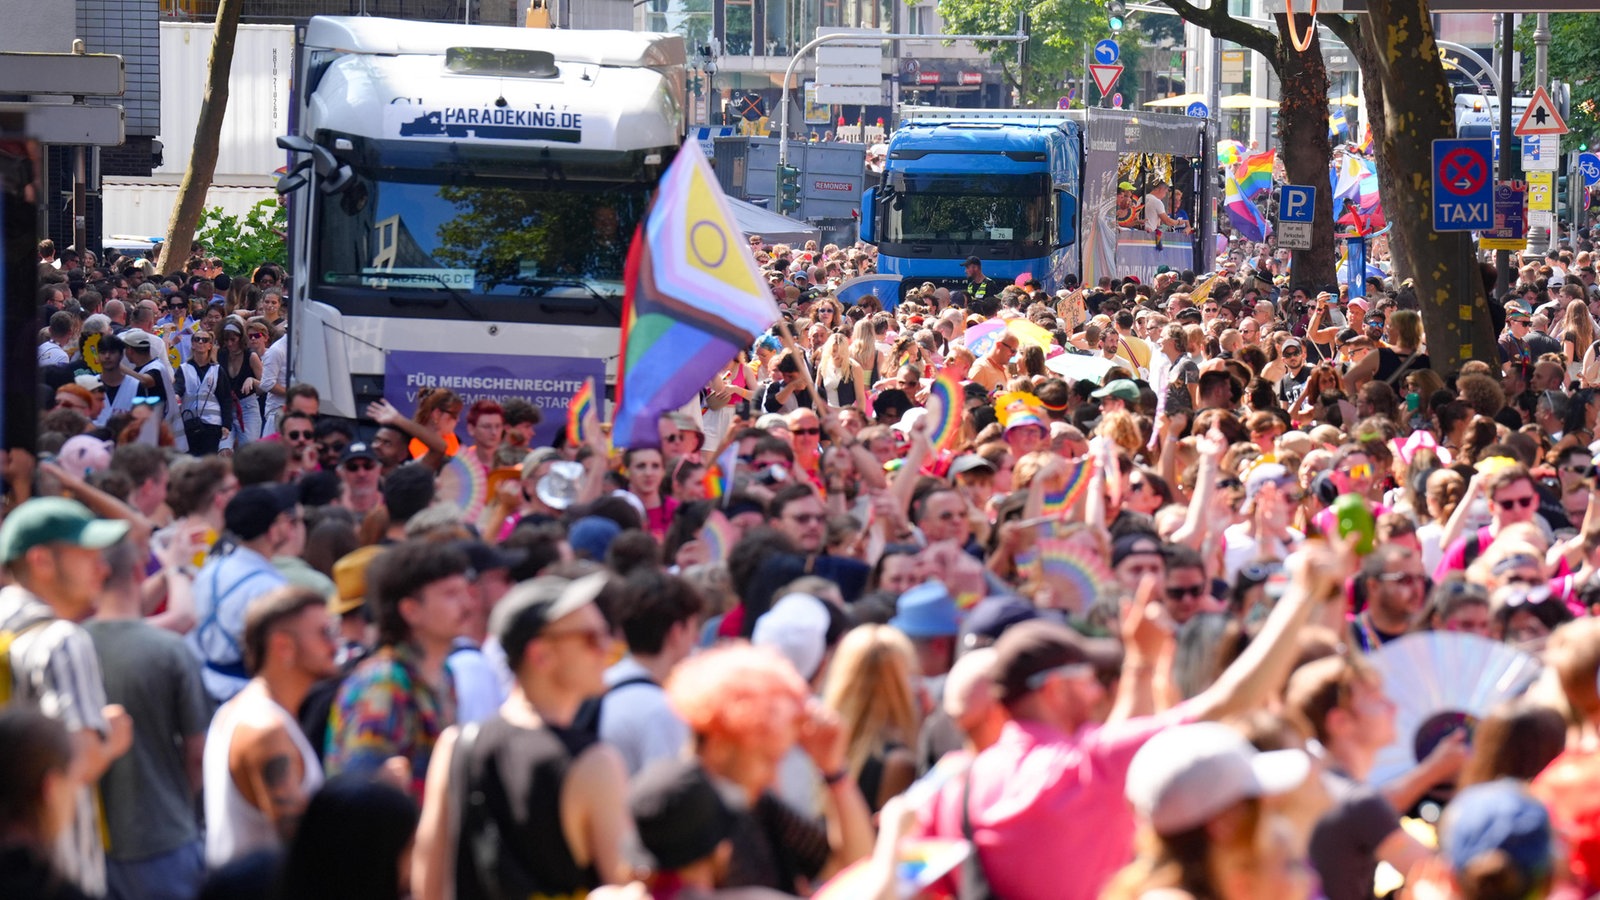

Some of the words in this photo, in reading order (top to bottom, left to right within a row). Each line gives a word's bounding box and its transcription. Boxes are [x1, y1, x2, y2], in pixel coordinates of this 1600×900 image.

[444, 108, 582, 129] PARADEKING.DE
[815, 182, 849, 191] REMONDIS
[1287, 190, 1306, 217] P
[1438, 202, 1488, 223] TAXI
[406, 372, 437, 387] FÜR
[535, 396, 572, 409] STAR
